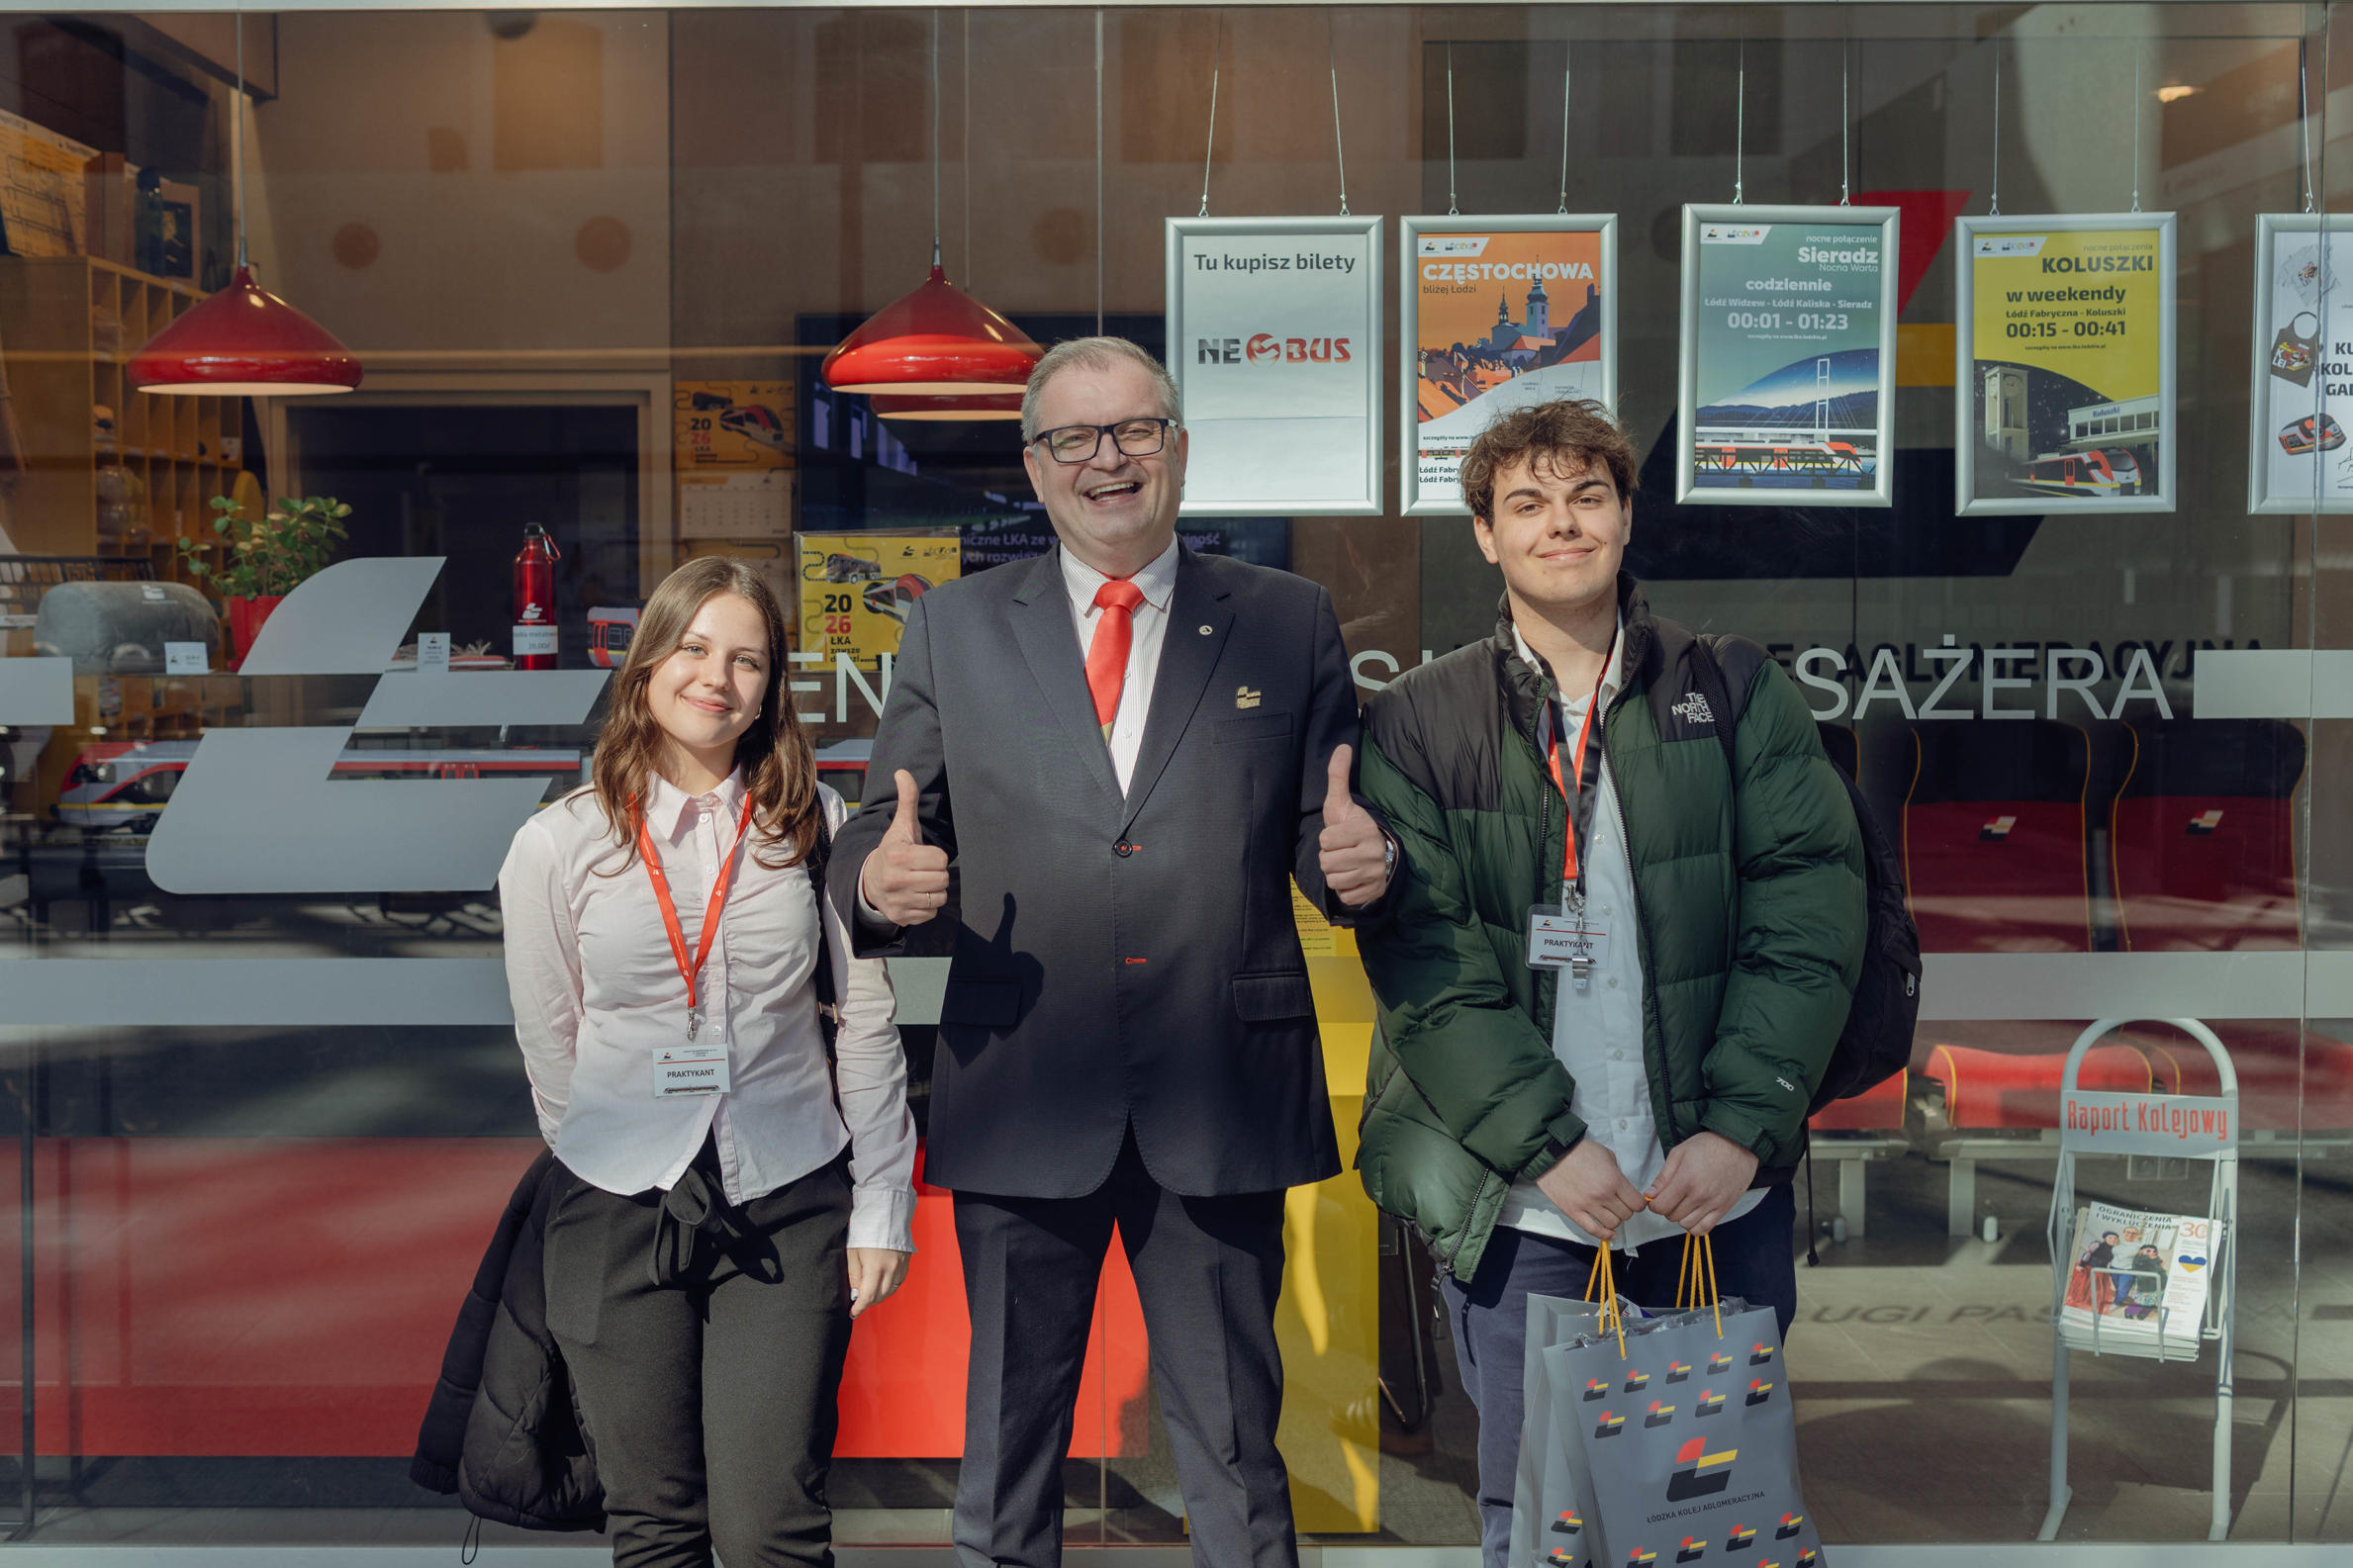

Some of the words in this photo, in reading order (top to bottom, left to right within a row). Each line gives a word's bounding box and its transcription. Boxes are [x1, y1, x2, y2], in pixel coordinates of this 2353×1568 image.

[1194, 254, 1217, 270] Tu
[1223, 253, 1290, 274] kupisz
[1296, 252, 1356, 274] bilety
[1798, 246, 1878, 264] Sieradz
[2042, 255, 2153, 273] KOLUSZKI
[1423, 262, 1594, 285] CZĘSTOCHOWA
[1423, 284, 1450, 295] bliżej
[1745, 278, 1833, 292] codziennie
[2007, 291, 2024, 303] w
[2026, 285, 2126, 304] weekendy
[1704, 298, 1728, 307] Łódź
[1729, 299, 1766, 308] Widzew
[1772, 298, 1795, 308] Łódź
[1796, 299, 1831, 308] Kaliska
[1837, 300, 1873, 309] Sieradz
[1728, 313, 1781, 329] 00:01
[1798, 313, 1848, 329] 01:23
[2006, 309, 2028, 319] Łódź
[2029, 309, 2079, 320] Fabryczna
[2085, 308, 2126, 318] Koluszki
[2007, 322, 2057, 338] 00:15
[2074, 321, 2125, 336] 00:41
[691, 417, 711, 431] 20
[1439, 466, 1460, 475] Fabry
[1439, 476, 1460, 485] Fabry
[824, 594, 853, 613] 20
[824, 614, 852, 634] 26
[830, 636, 852, 645] ŁKA
[1795, 634, 2174, 720] SAŻERA
[1686, 711, 1716, 724] FACE
[667, 1068, 715, 1078] PRAKTYKANT
[2067, 1100, 2129, 1137] Raport
[2137, 1101, 2228, 1141] Kolejowy
[2098, 1205, 2173, 1224] OGRANICZENIA
[1678, 1505, 1702, 1517] KOLEJ
[1702, 1490, 1766, 1511] AGLOMERACYJNA
